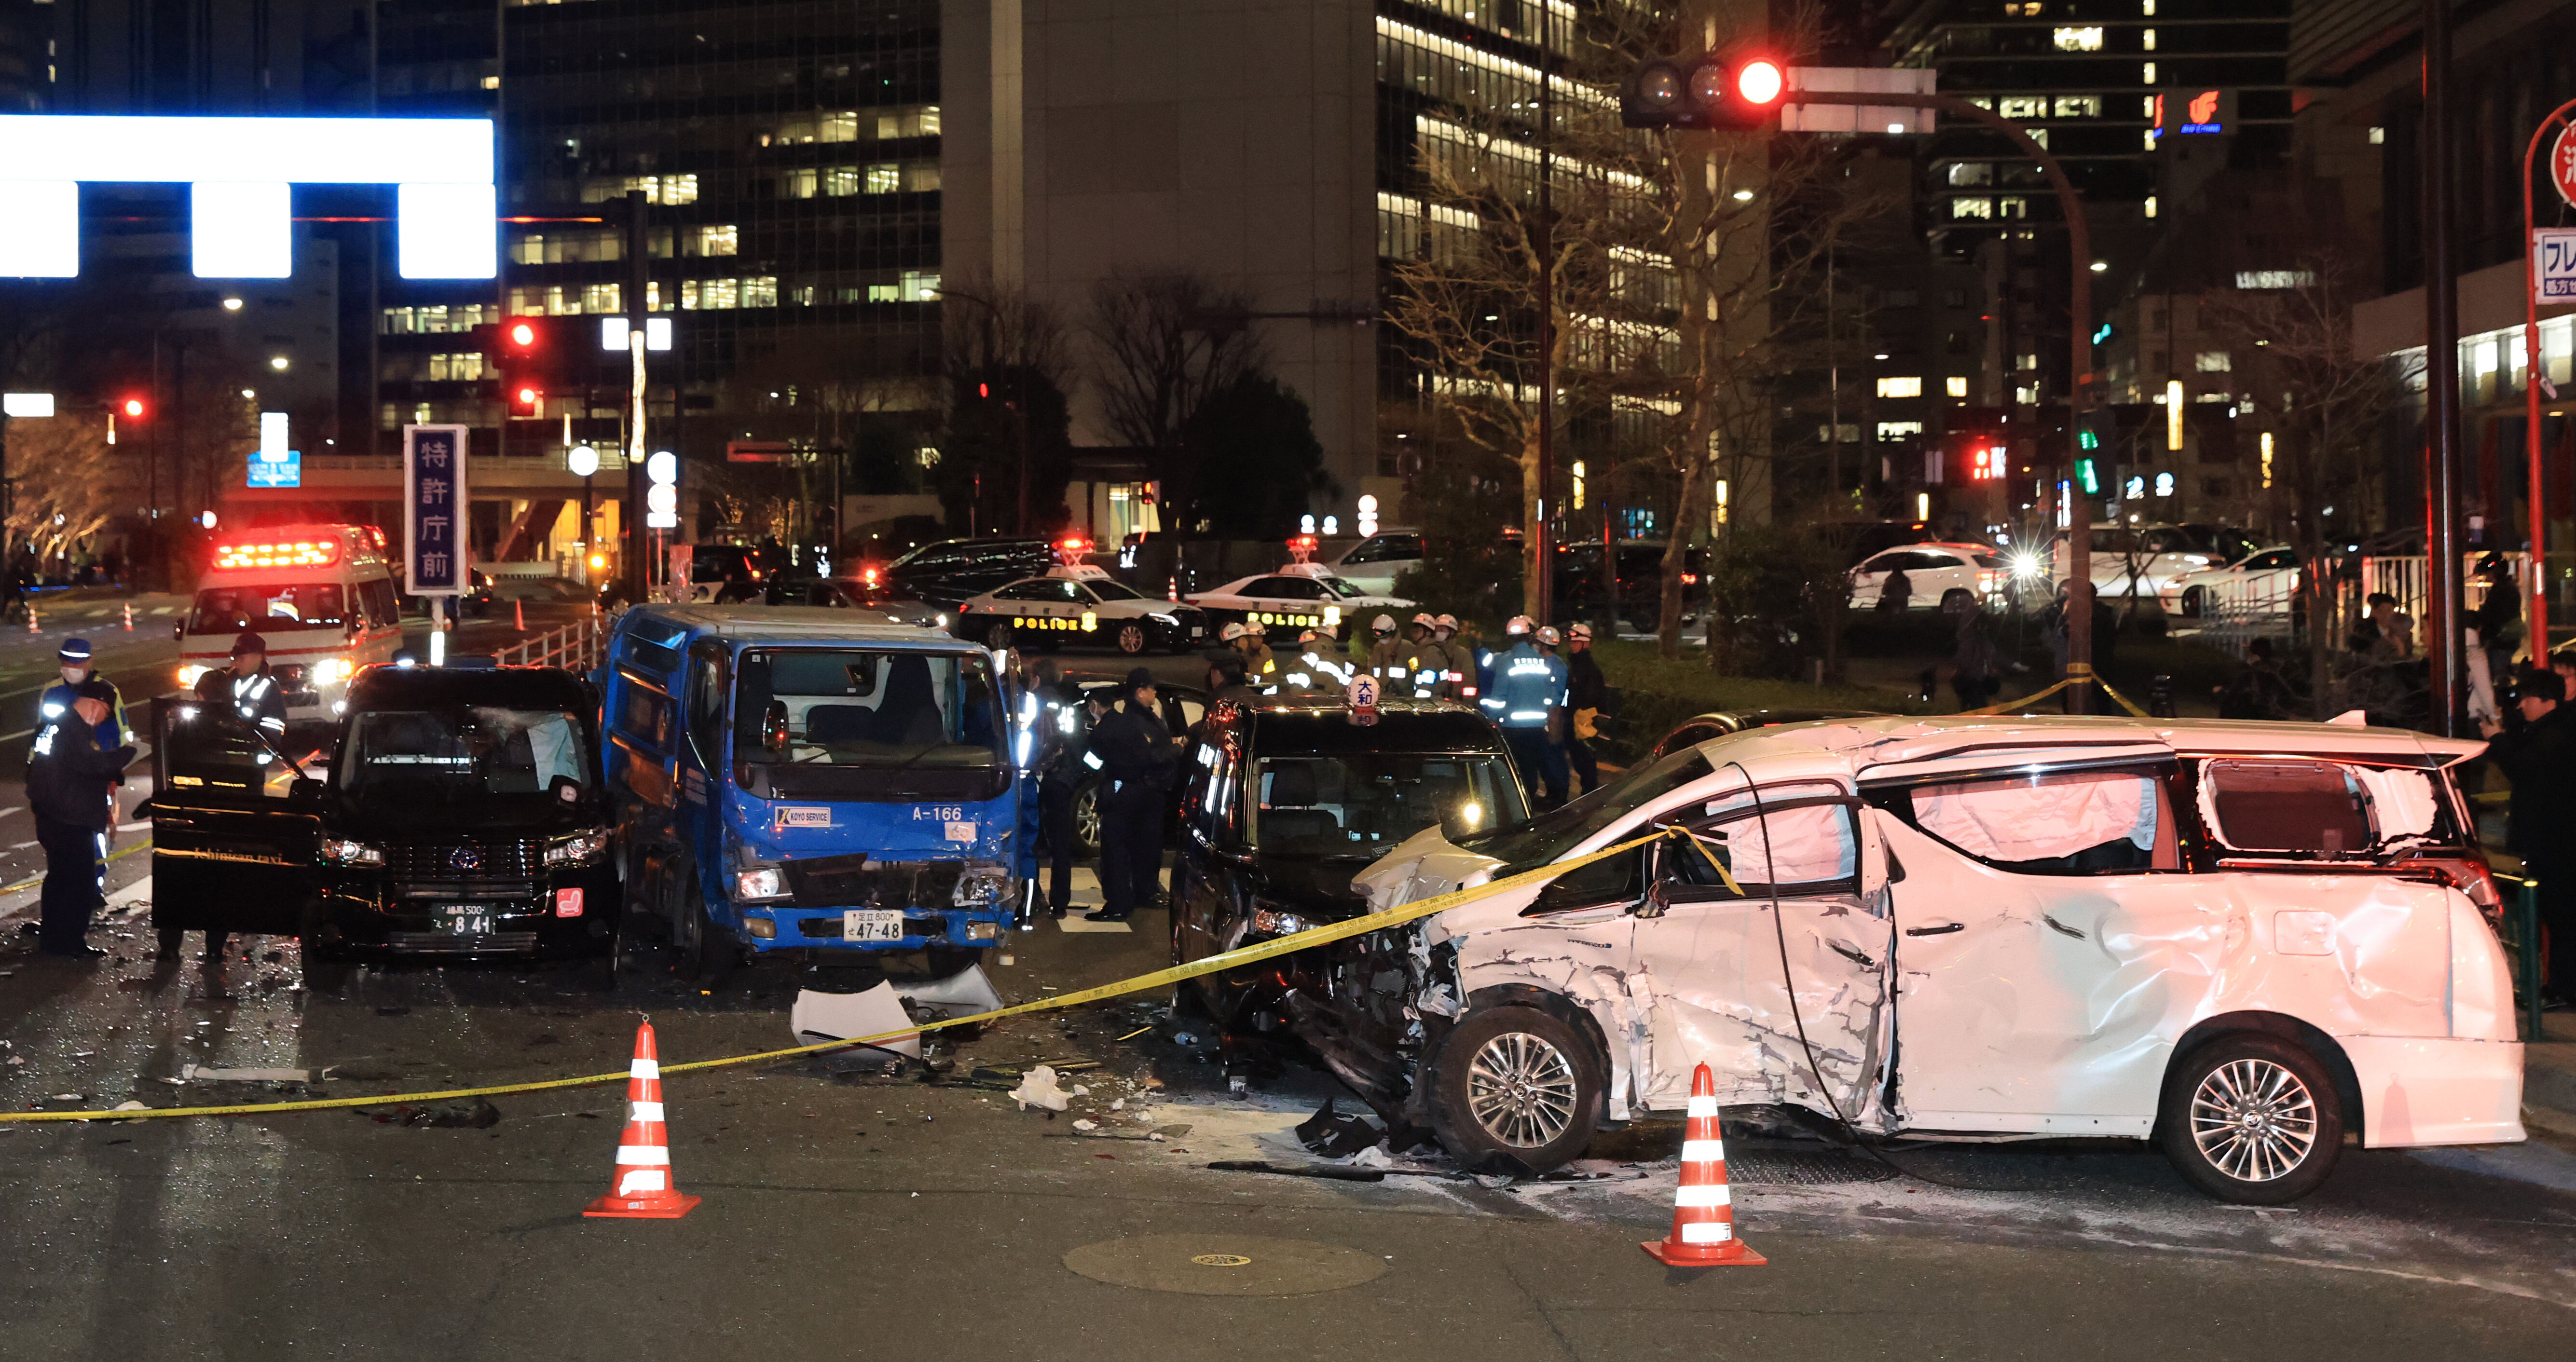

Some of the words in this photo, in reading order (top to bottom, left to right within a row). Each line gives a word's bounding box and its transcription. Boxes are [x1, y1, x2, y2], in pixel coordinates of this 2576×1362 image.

[420, 441, 448, 578] 特許庁前
[1014, 617, 1078, 630] POLICE
[1248, 612, 1318, 627] POLICE
[1357, 681, 1372, 705] 大和
[790, 812, 805, 821] KOYO
[806, 813, 827, 821] SERVICE
[913, 806, 961, 821] A-166
[466, 905, 482, 915] 500
[857, 923, 899, 938] 47-48
